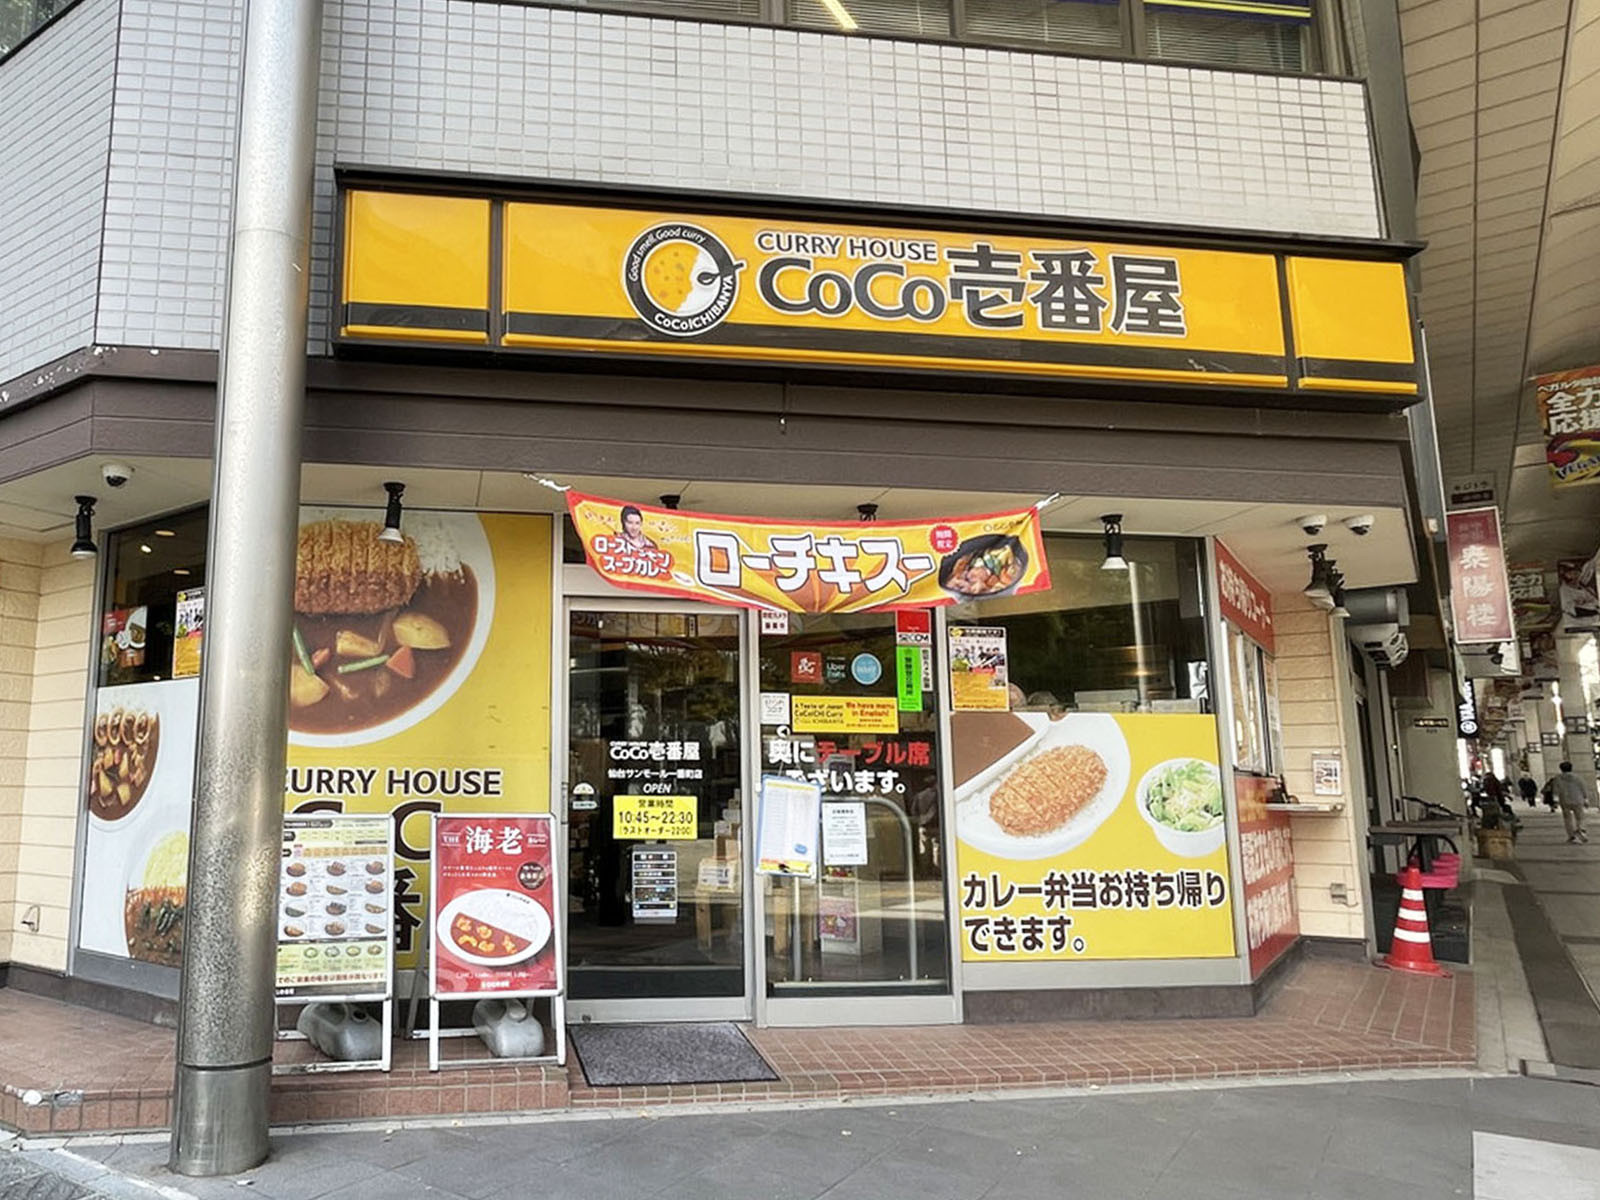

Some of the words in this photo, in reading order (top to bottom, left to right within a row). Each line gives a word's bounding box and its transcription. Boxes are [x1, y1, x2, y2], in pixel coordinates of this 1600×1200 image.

[757, 232, 842, 255] CURRY
[849, 238, 938, 263] HOUSE
[758, 243, 1186, 336] CoCo壱番屋
[603, 555, 668, 577] スープカレー
[696, 531, 934, 594] ローチキスー
[768, 738, 931, 766] 奥にテーブル席
[284, 768, 377, 794] URRY
[387, 769, 501, 795] HOUSE
[642, 782, 672, 794] OPEN
[466, 825, 523, 855] 海老
[963, 870, 1226, 909] カレー弁当お持ち帰り
[964, 915, 1086, 953] できます。
